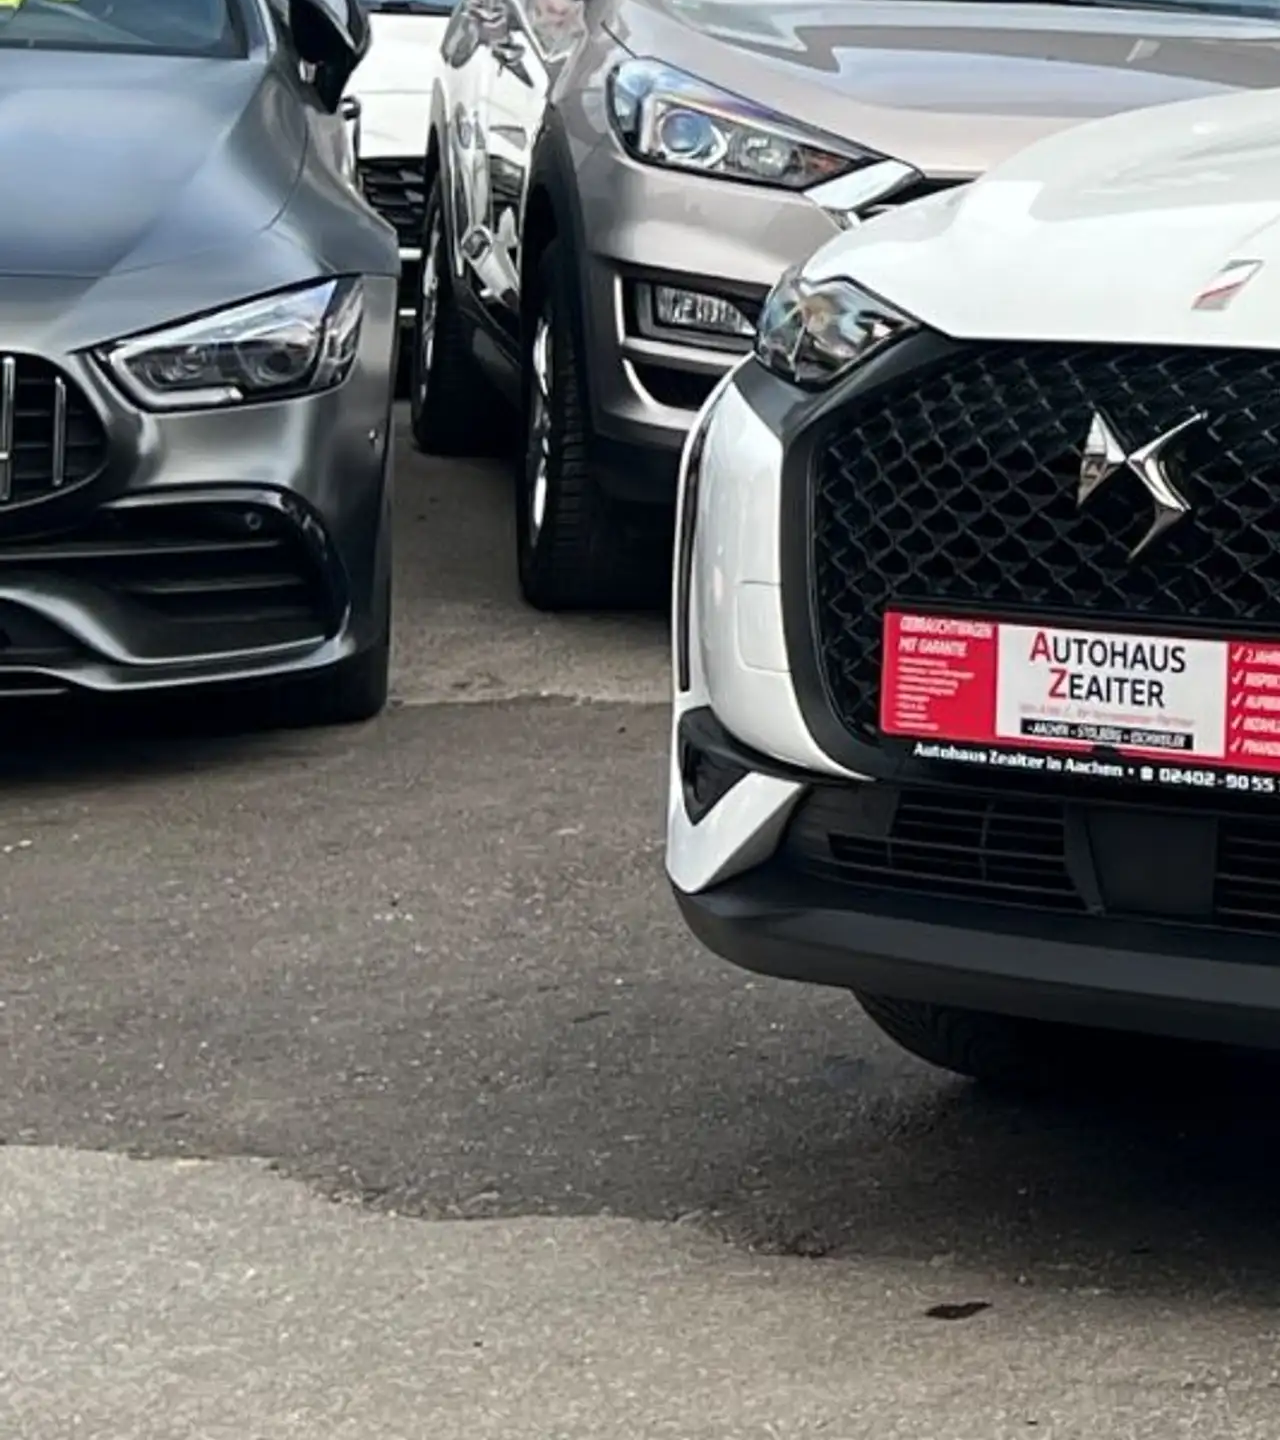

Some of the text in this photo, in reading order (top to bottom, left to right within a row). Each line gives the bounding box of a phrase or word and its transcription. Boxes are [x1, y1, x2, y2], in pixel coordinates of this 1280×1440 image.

[1030, 631, 1186, 674] AUTOHAUS
[1048, 668, 1165, 708] ZEAITER
[913, 741, 987, 764] Autohaus
[1063, 757, 1124, 778] Aachen
